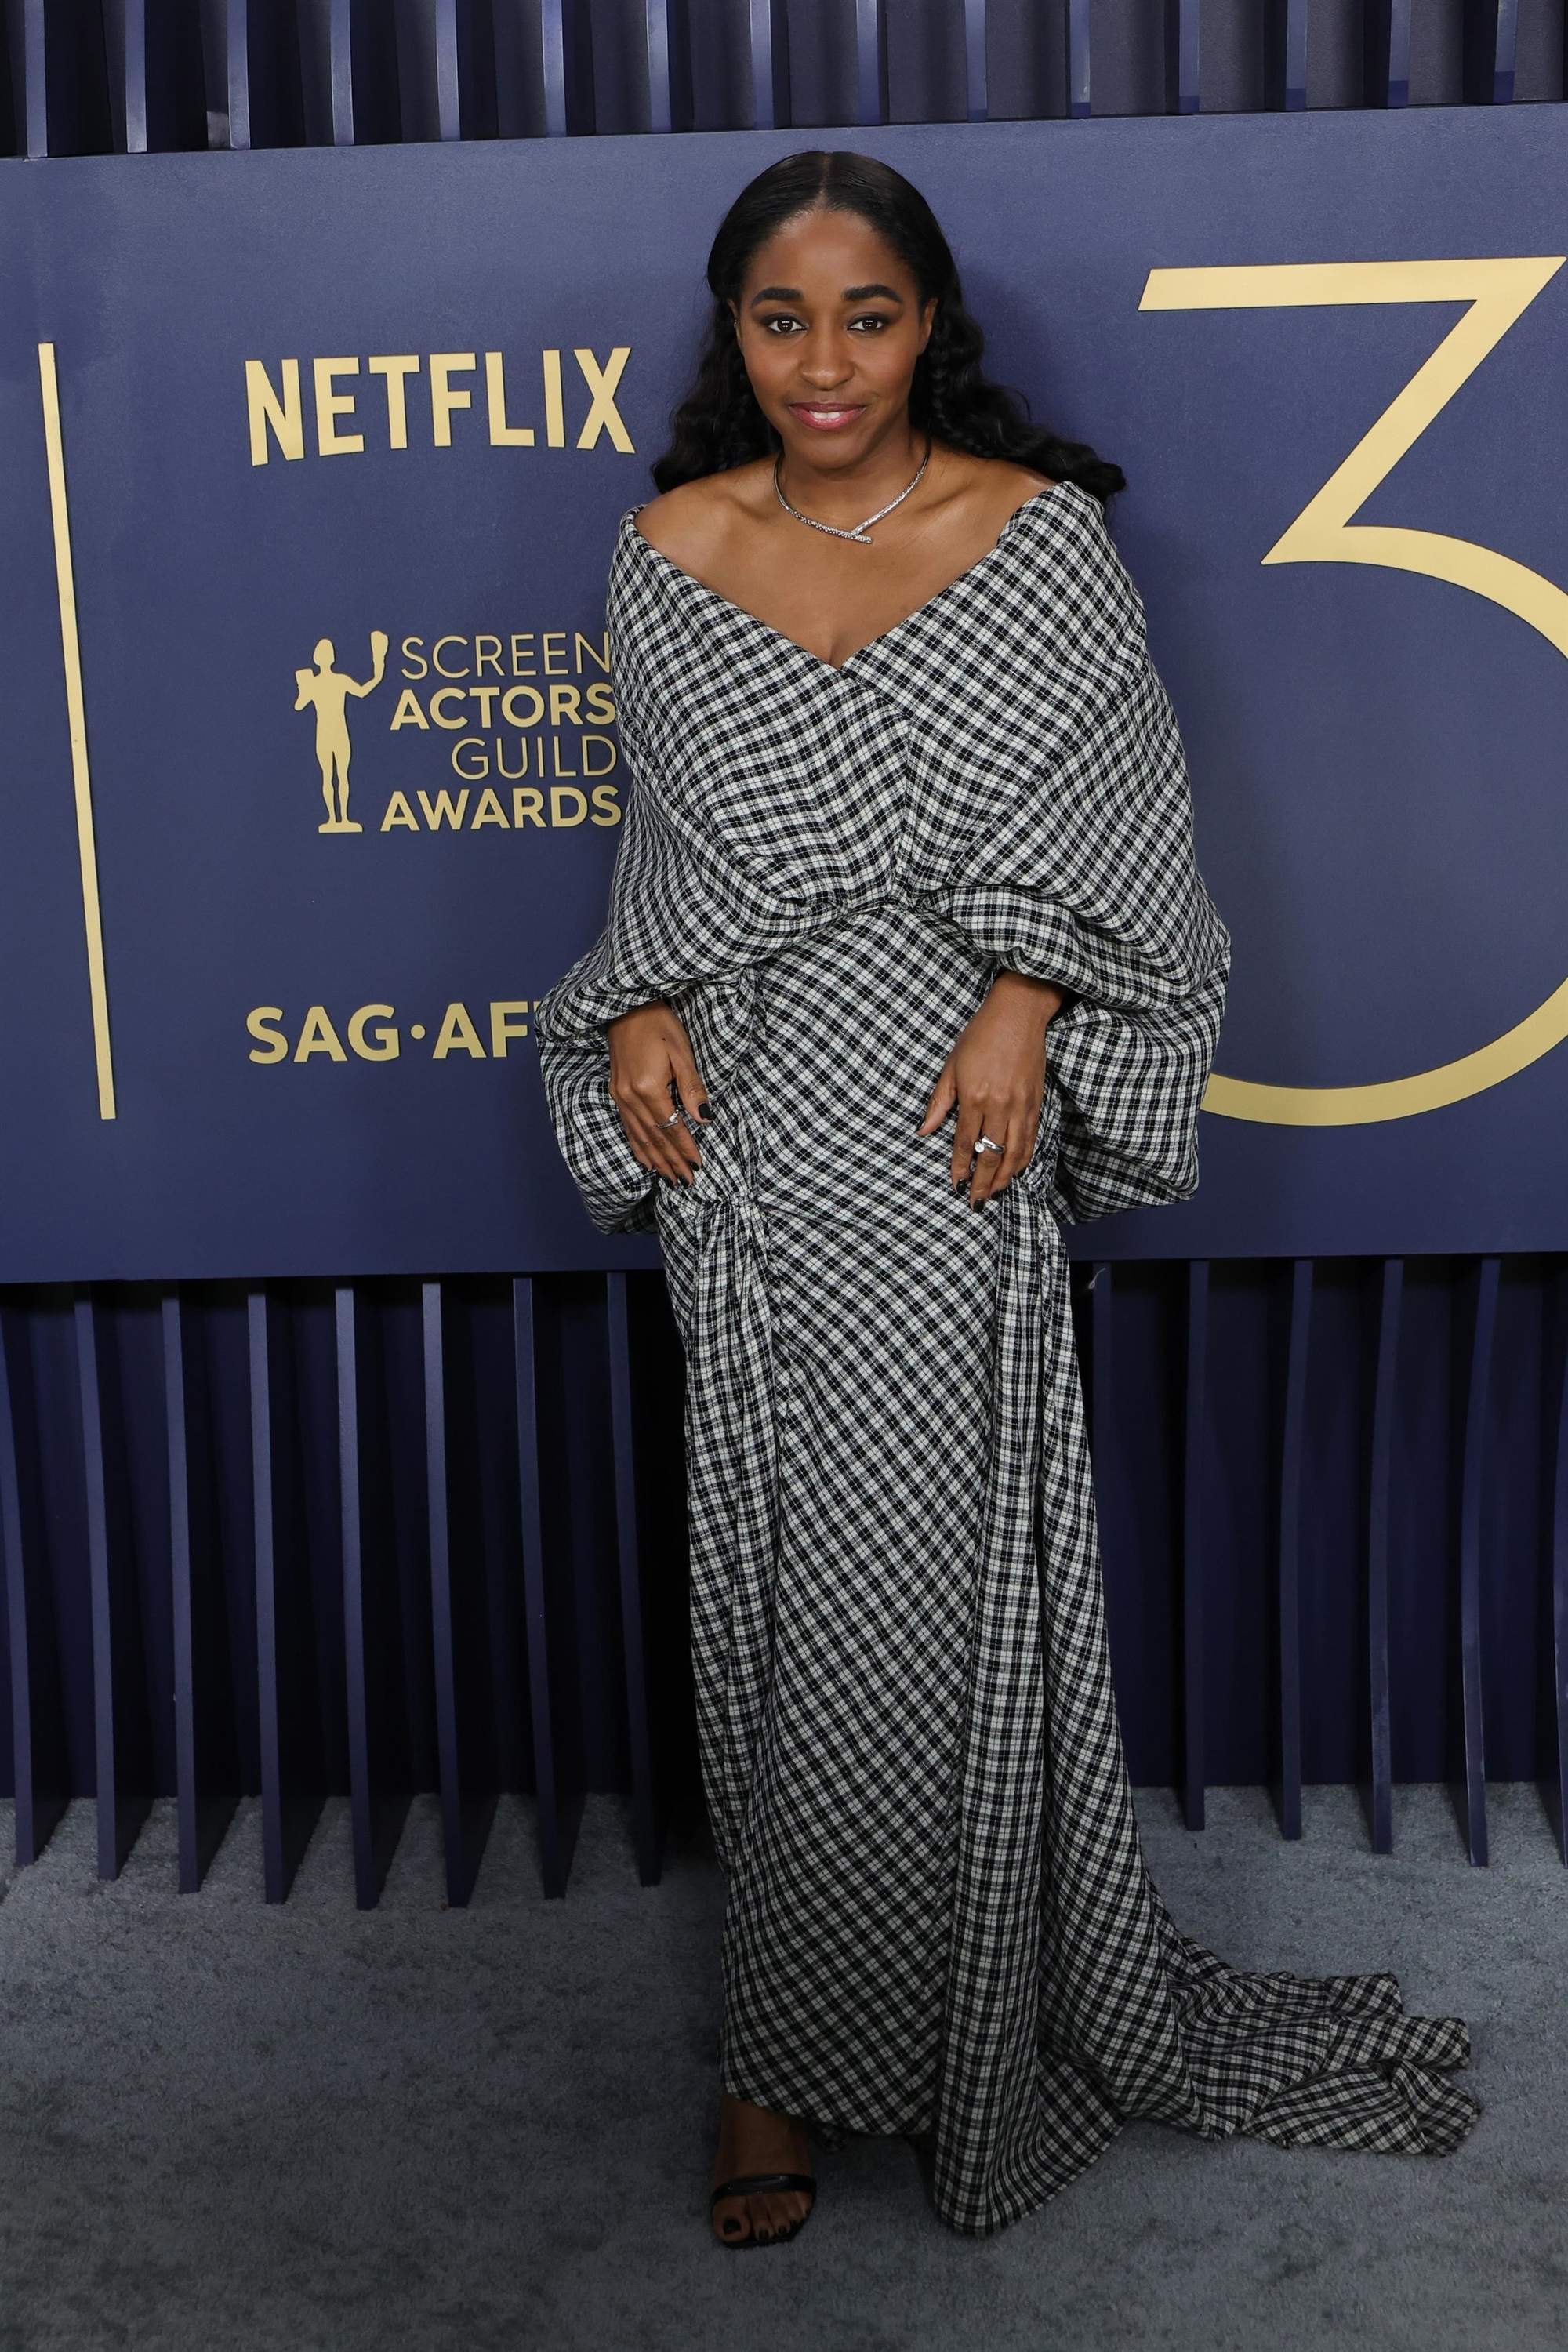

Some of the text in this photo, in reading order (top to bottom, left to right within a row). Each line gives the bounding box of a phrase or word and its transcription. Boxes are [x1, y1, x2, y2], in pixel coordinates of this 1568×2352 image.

[245, 347, 635, 466] NETFLIX
[401, 630, 611, 680] SCREEN
[390, 682, 617, 730] ACTORS
[451, 735, 617, 780] GUILD
[380, 785, 622, 833] AWARDS
[246, 1000, 541, 1065] SAG·AF
